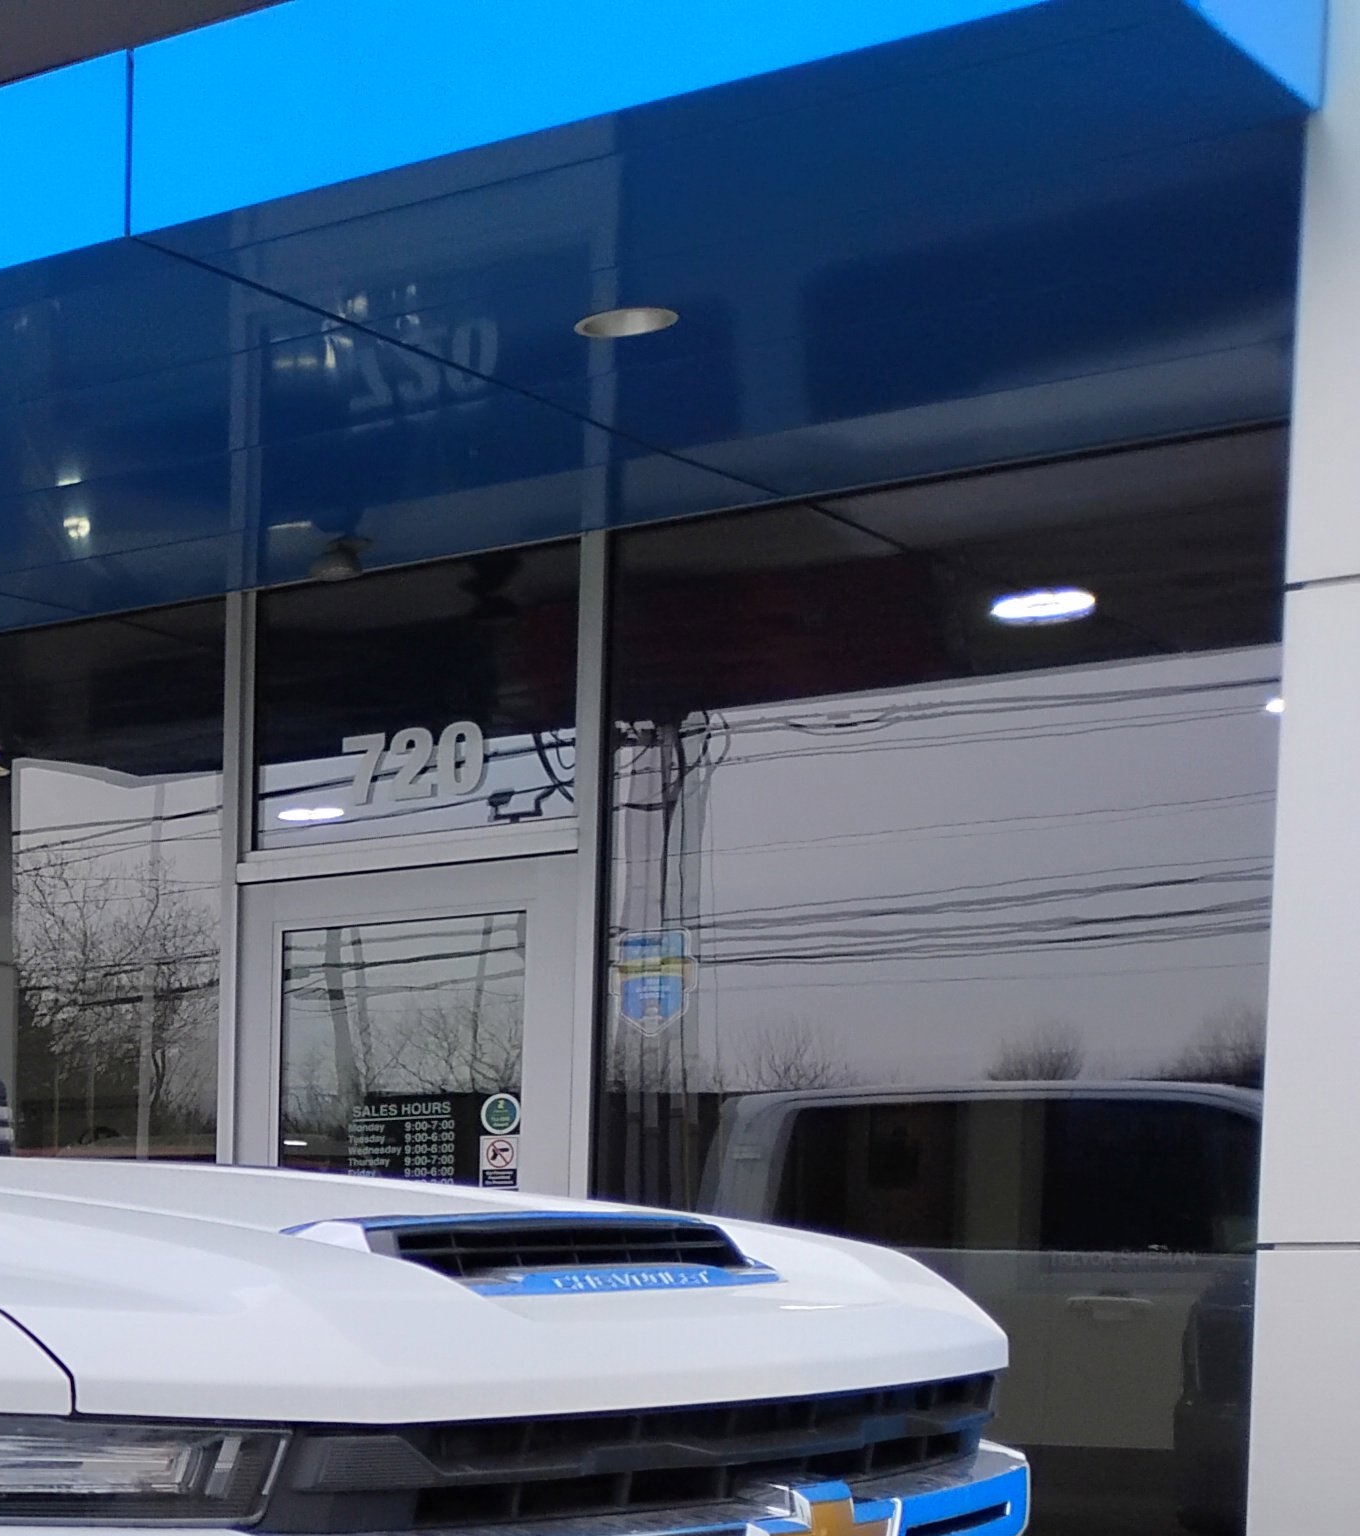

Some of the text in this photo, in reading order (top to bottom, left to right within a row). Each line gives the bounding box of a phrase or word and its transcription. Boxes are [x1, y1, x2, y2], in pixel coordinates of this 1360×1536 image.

[342, 720, 486, 806] 720
[352, 1101, 452, 1118] SALES HOURS
[348, 1120, 455, 1133] Monday 9:00-7:00
[348, 1131, 455, 1145] Tuesday 9:00-6:00
[348, 1143, 455, 1155] Wednesday 9:00-6:00
[348, 1155, 454, 1167] Thursday 9:00-7:00
